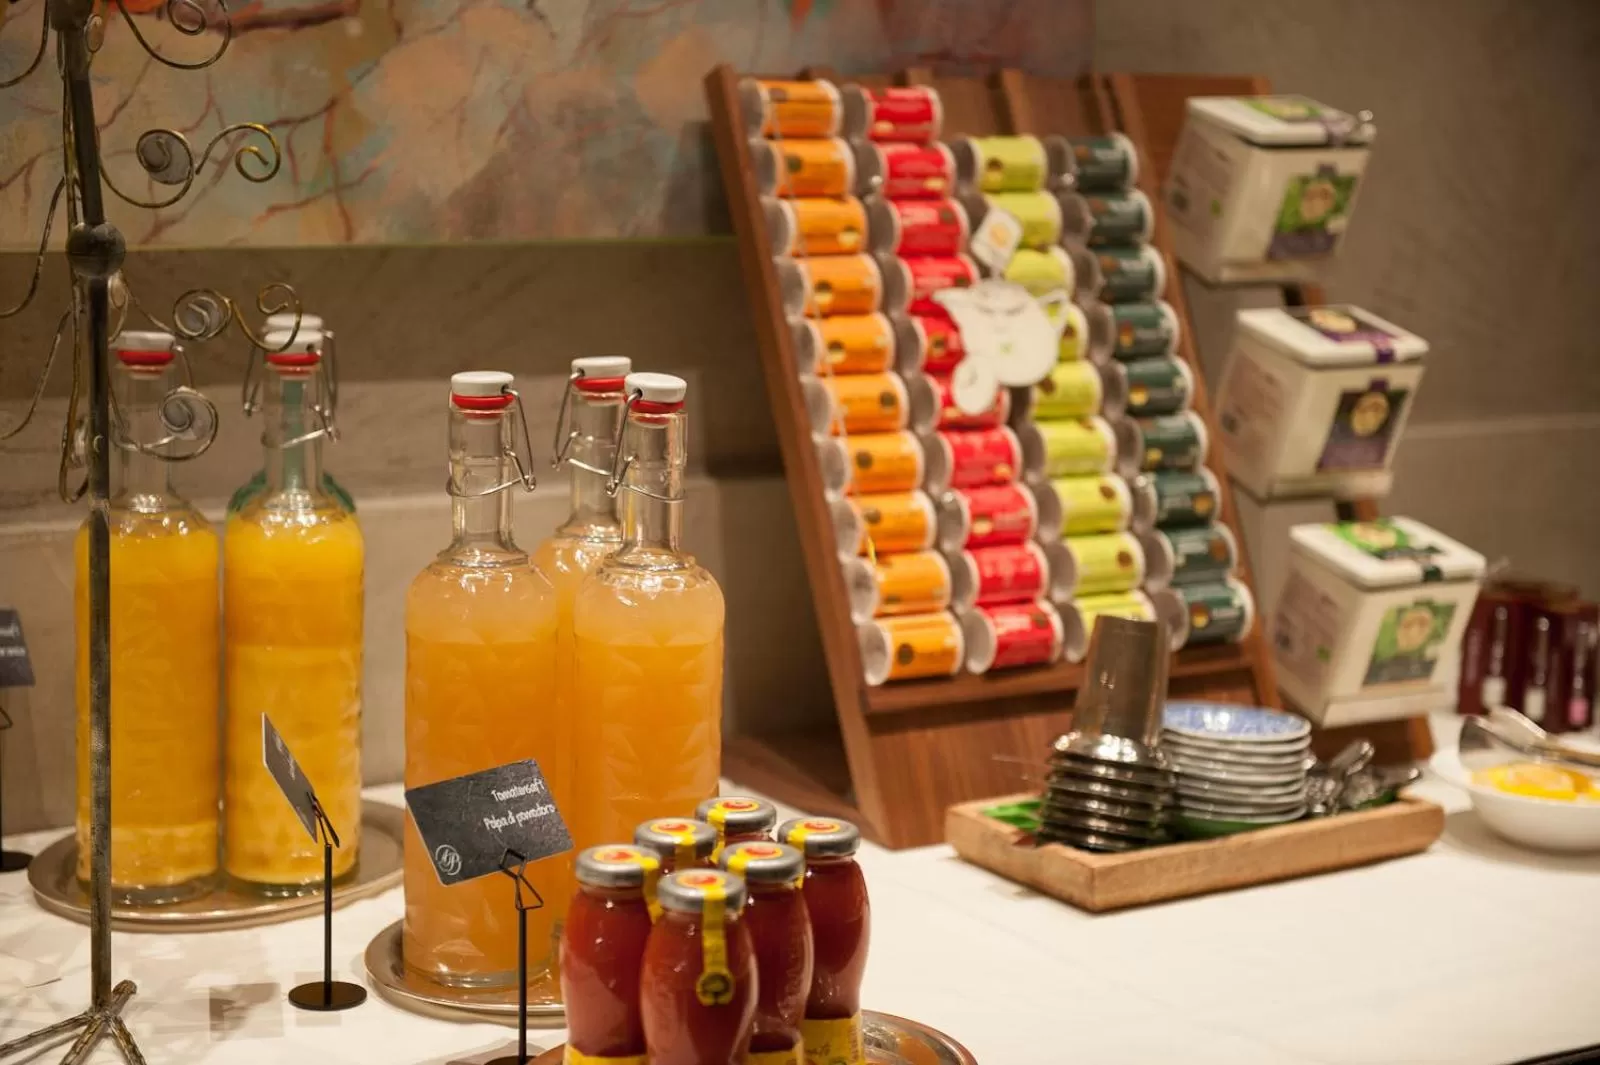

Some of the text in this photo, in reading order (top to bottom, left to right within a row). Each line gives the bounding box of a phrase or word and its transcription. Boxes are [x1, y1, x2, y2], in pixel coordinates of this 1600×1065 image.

[491, 777, 544, 802] Tomatensaft
[483, 803, 556, 833] Polpa di pomodoro
